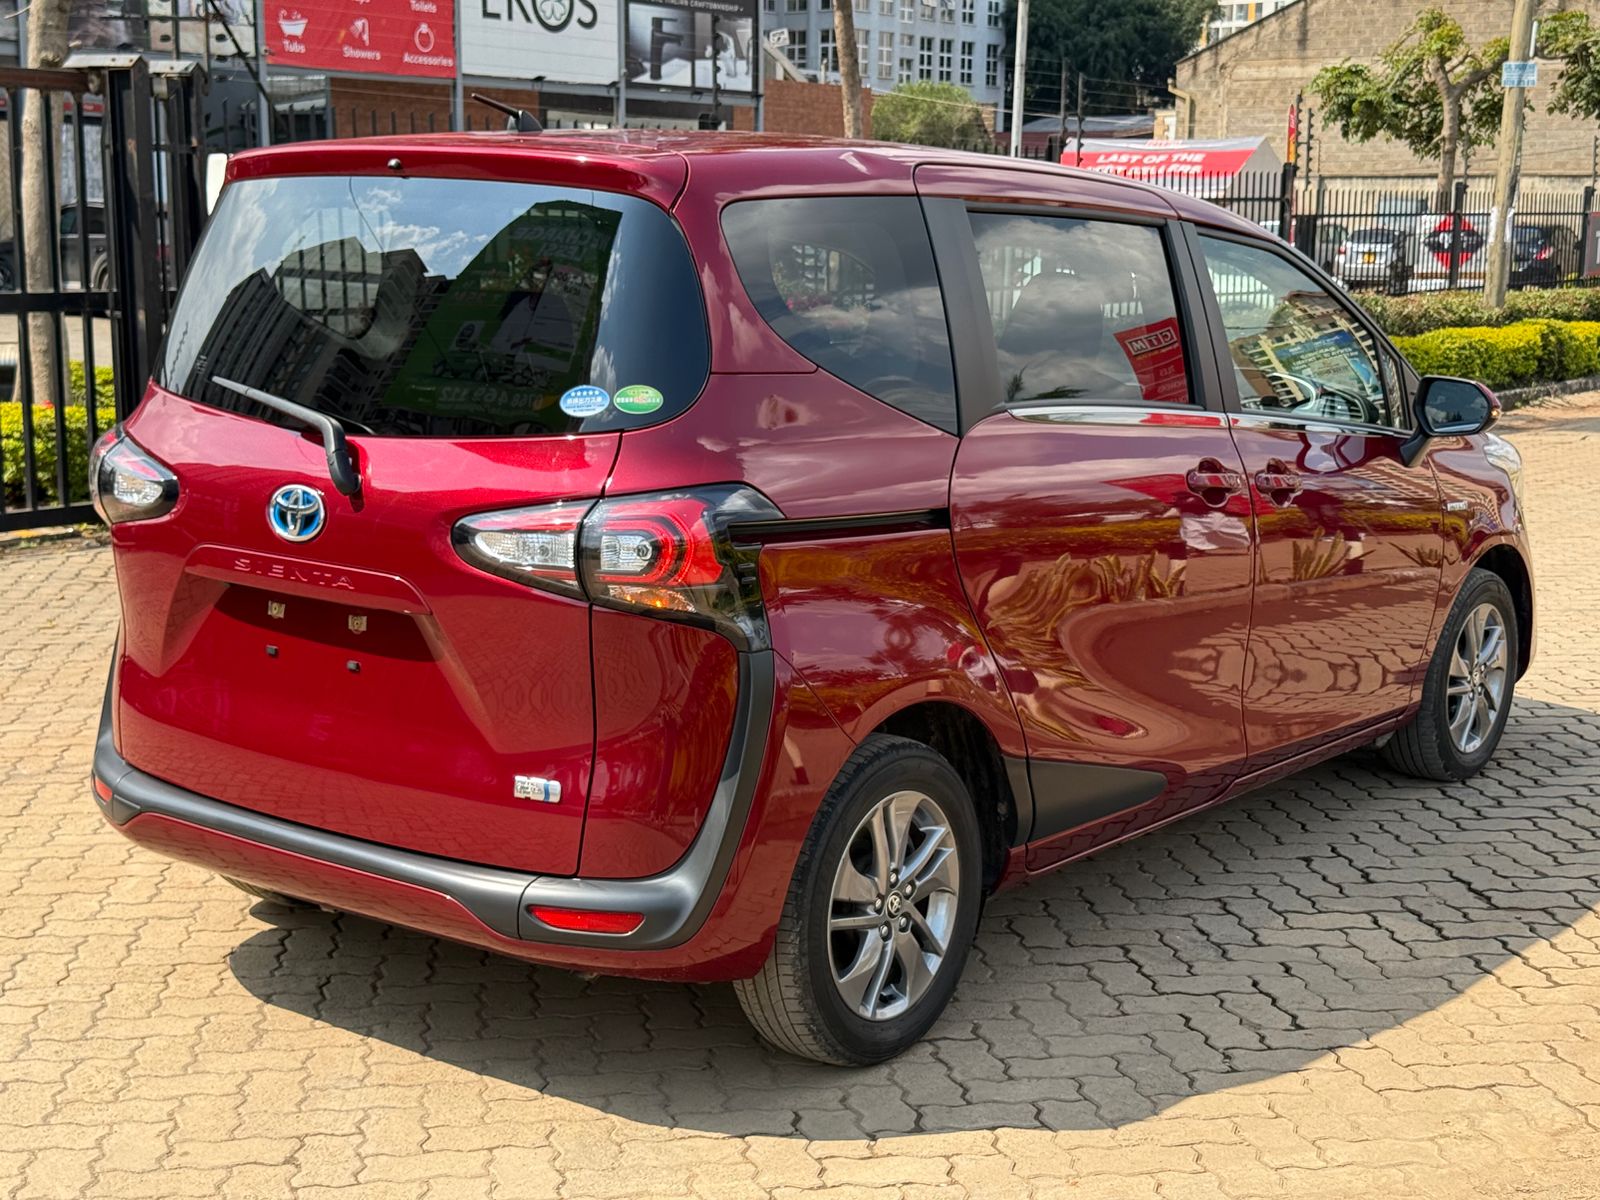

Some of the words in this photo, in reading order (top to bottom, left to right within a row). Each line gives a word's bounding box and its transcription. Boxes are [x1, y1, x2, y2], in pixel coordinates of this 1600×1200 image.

[410, 0, 437, 13] Toilets
[282, 39, 306, 53] Tubs
[342, 45, 381, 60] Showers
[403, 52, 454, 67] Accessories
[1096, 153, 1142, 164] LAST
[1143, 154, 1169, 164] OF
[1171, 152, 1206, 163] THE
[234, 558, 355, 590] SIENTA
